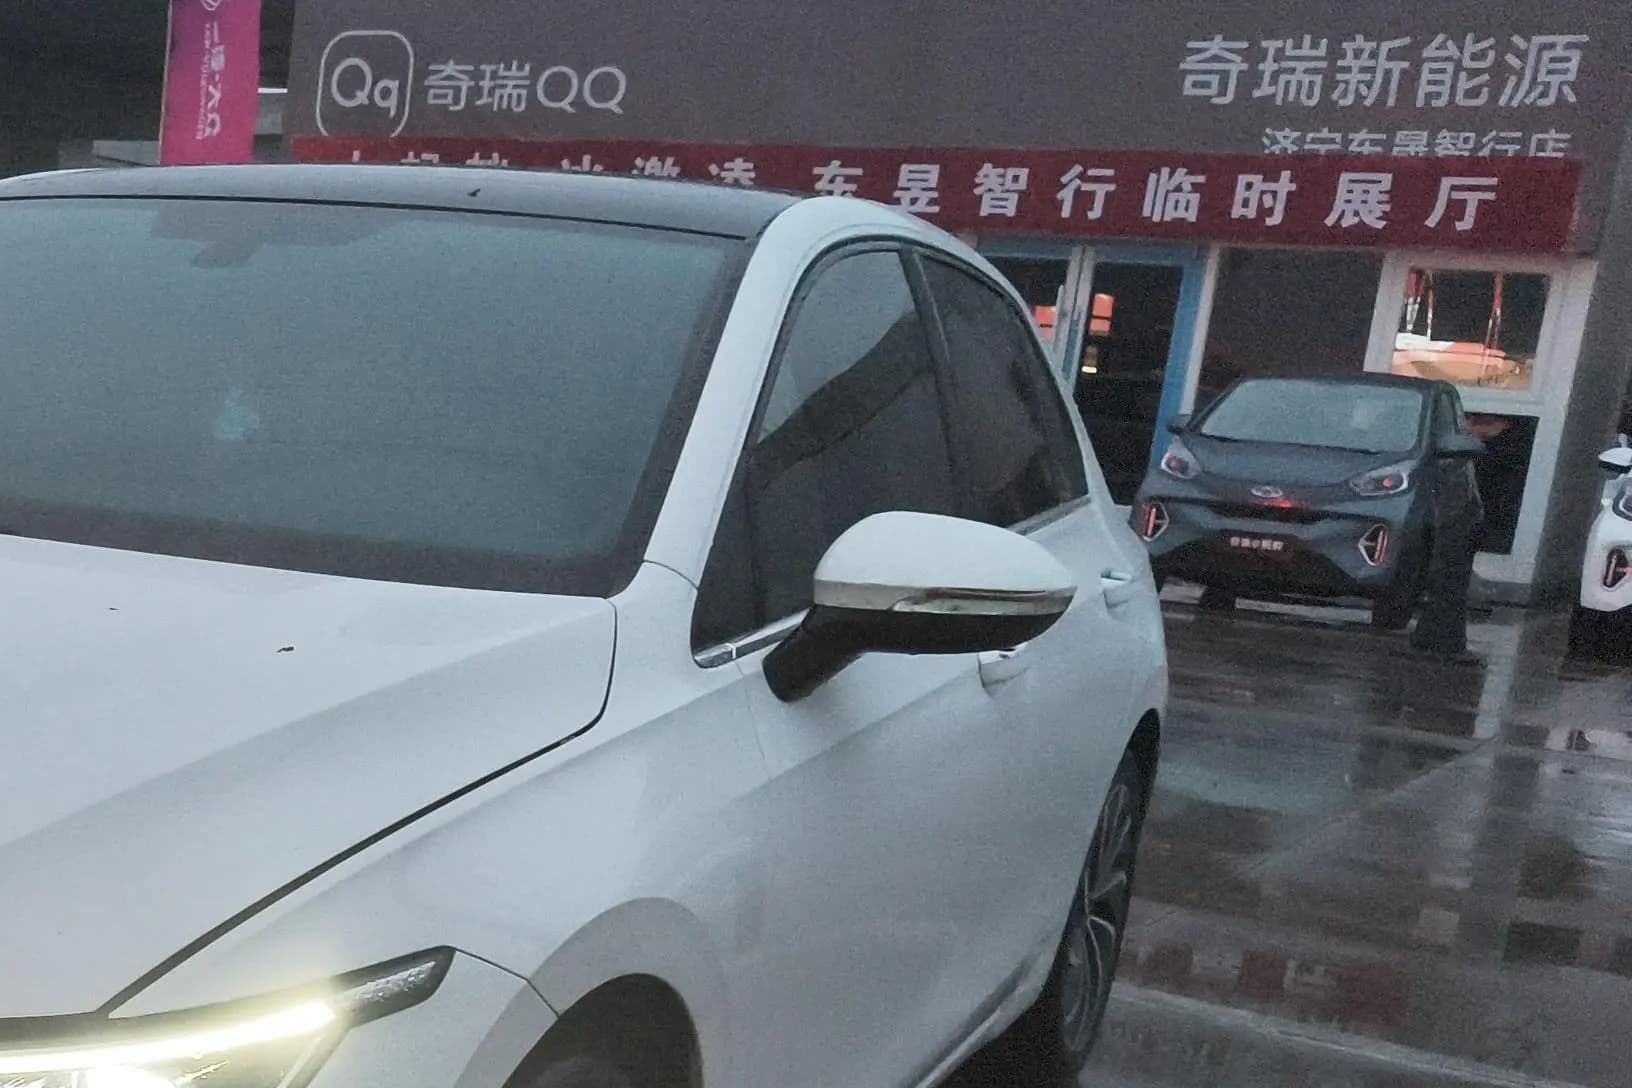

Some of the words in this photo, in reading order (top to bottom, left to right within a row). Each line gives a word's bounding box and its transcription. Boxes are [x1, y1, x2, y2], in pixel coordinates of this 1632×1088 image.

[423, 58, 627, 115] 奇瑞QQ
[1179, 33, 1589, 108] 奇瑞新能源
